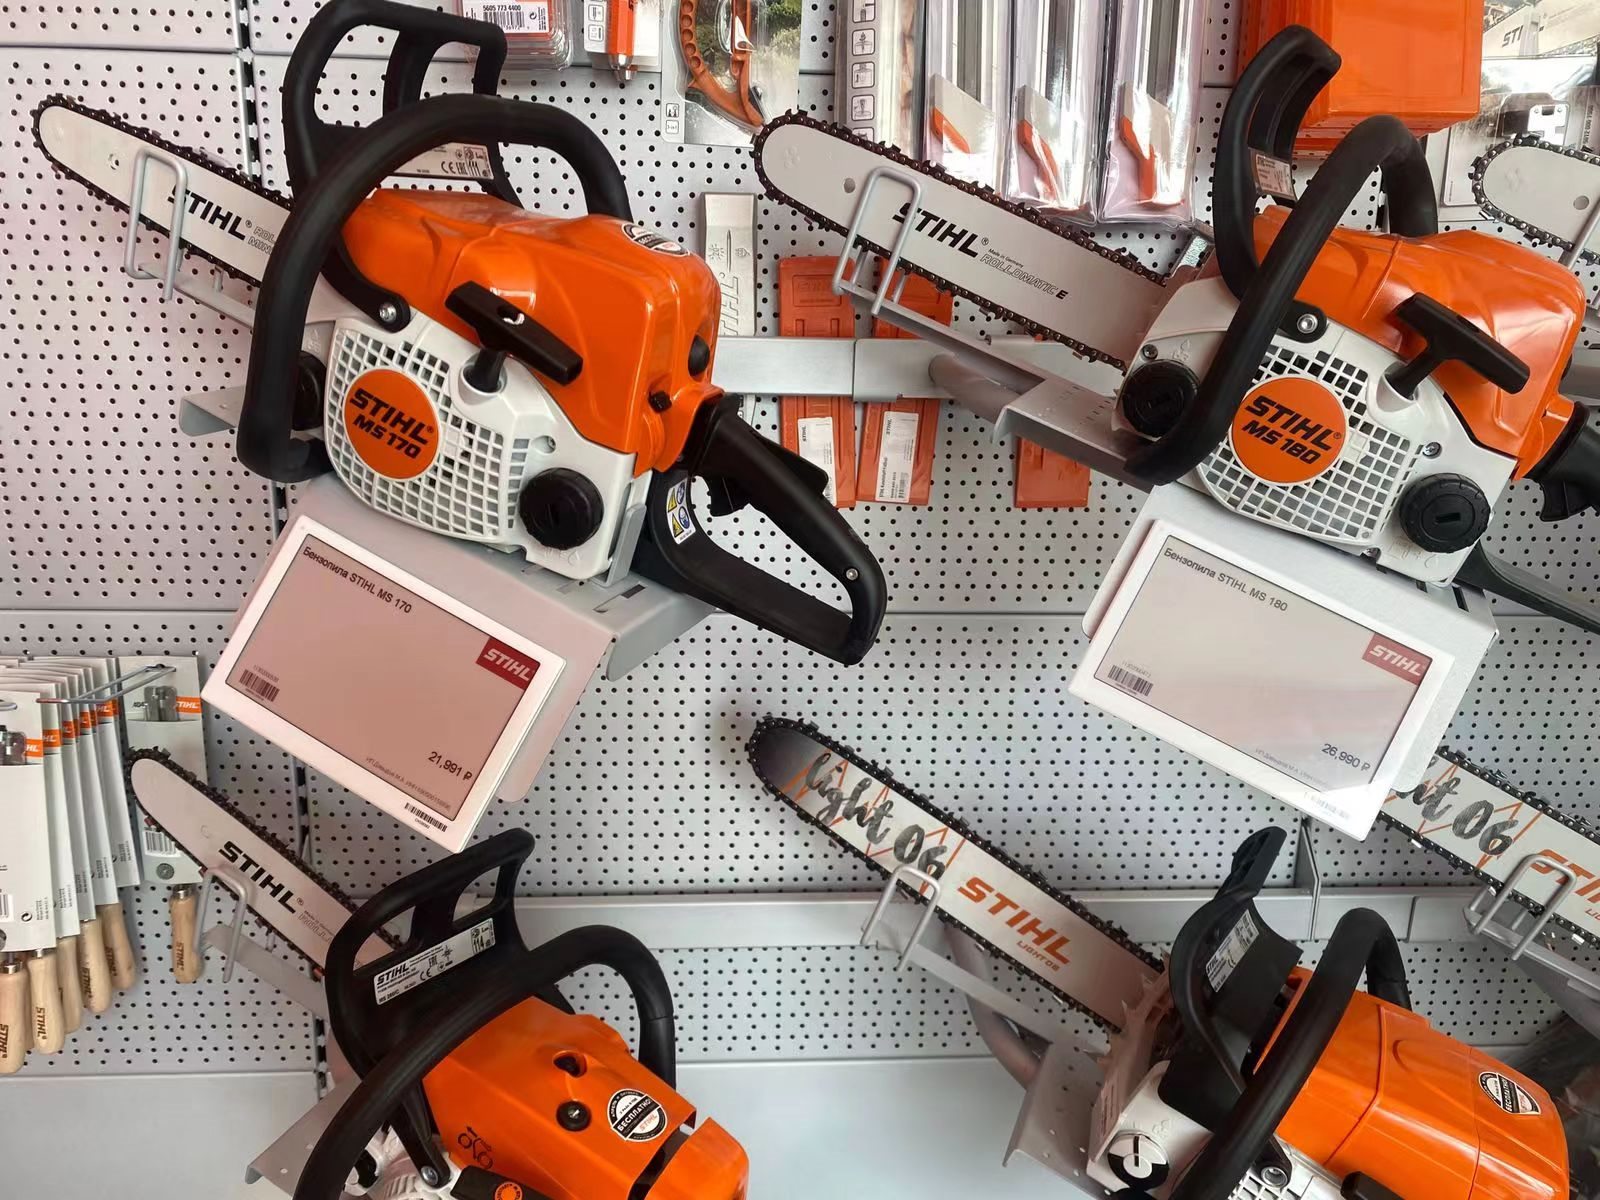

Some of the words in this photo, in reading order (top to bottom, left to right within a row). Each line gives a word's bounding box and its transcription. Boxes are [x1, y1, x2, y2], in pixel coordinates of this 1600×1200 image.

[980, 253, 1057, 295] ROLLOMATIC
[1056, 289, 1069, 300] E
[350, 388, 429, 445] STIHL
[353, 414, 387, 440] MS
[387, 433, 422, 459] 170
[1245, 395, 1333, 451] STIHL
[1241, 420, 1283, 446] MS
[1280, 438, 1321, 464] 180
[303, 547, 349, 579] Бензопила
[349, 573, 376, 595] STIHL
[377, 588, 394, 603] MS
[395, 598, 412, 614] 170
[1164, 547, 1216, 578] Бензопила
[1217, 573, 1247, 593] STIHL
[1249, 587, 1267, 601] MS
[1269, 597, 1288, 612] 180
[484, 648, 530, 682] STIHL
[1369, 644, 1422, 676] STIHL
[428, 751, 463, 777] 21,991
[1321, 743, 1361, 768] 26,990
[1452, 800, 1519, 855] 06
[219, 841, 296, 914] STIHL
[957, 877, 1071, 965] STIHL
[377, 963, 409, 985] STIHL
